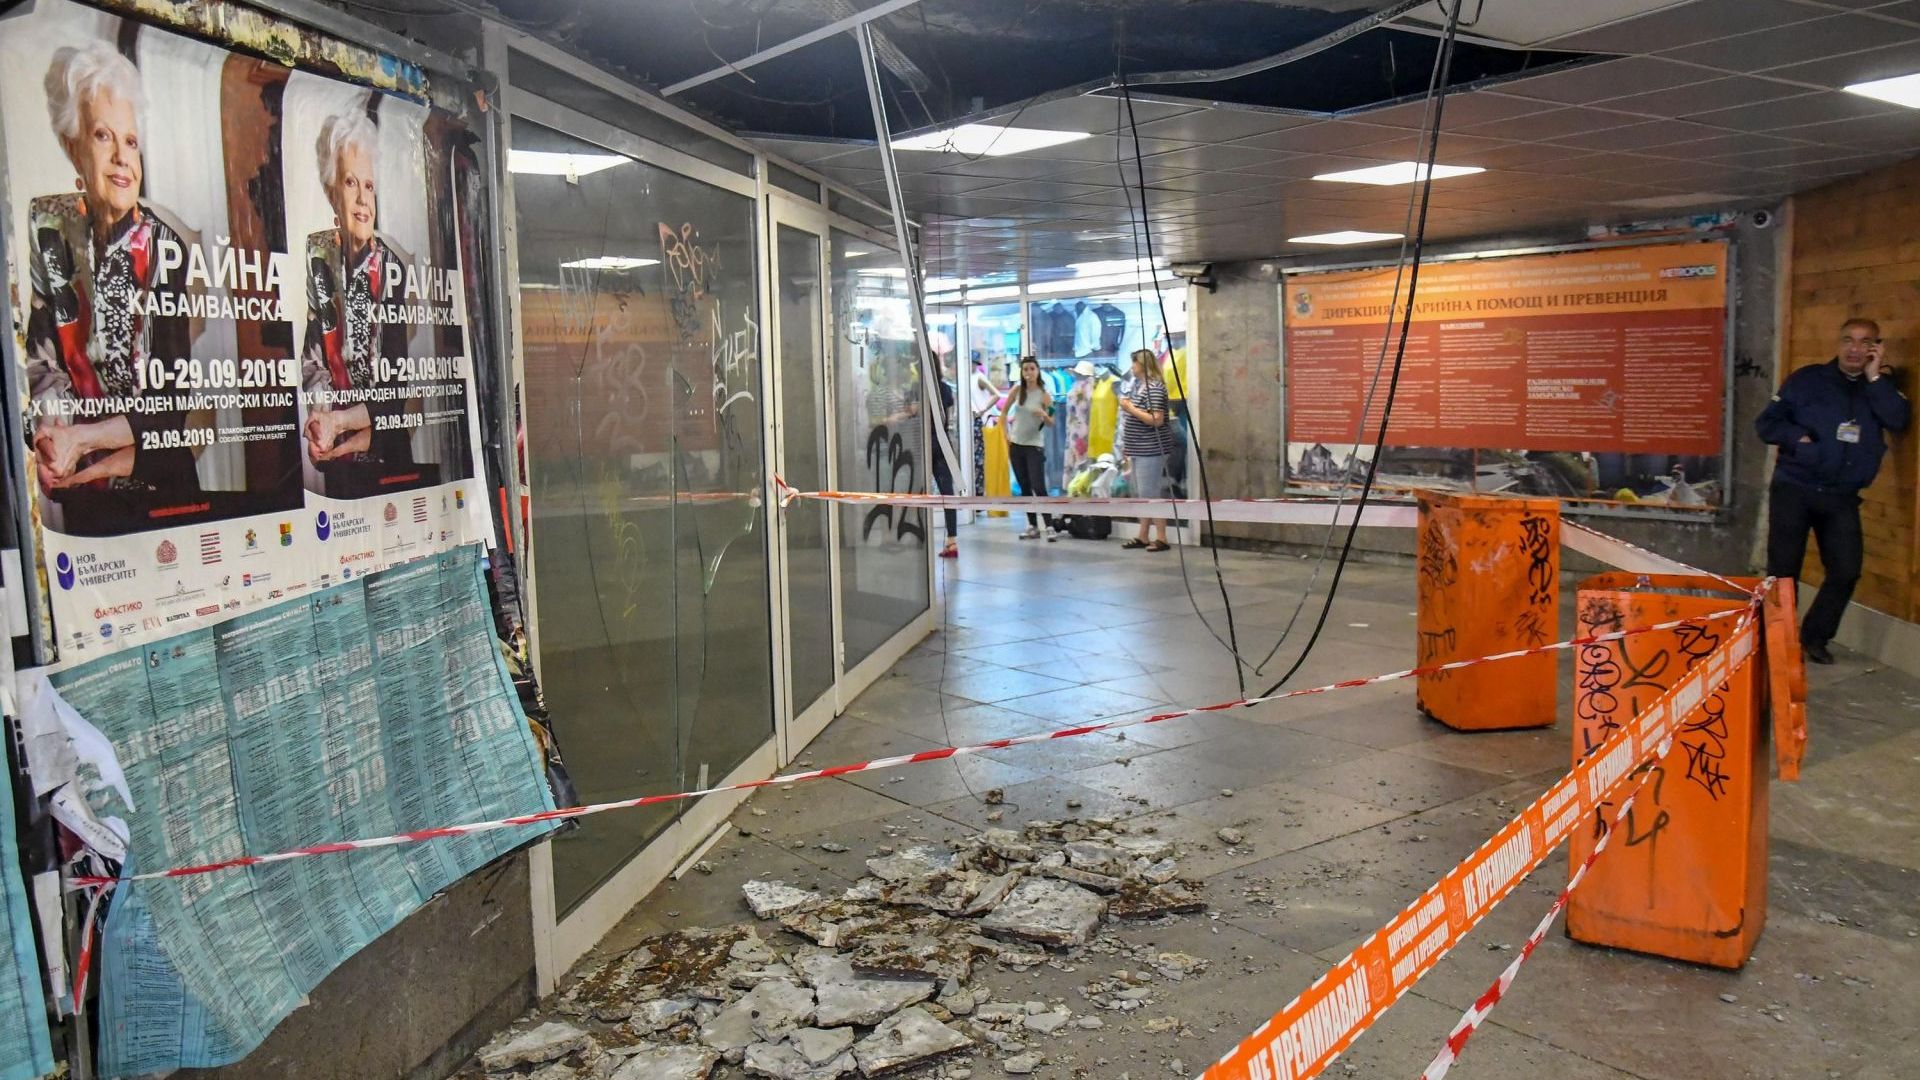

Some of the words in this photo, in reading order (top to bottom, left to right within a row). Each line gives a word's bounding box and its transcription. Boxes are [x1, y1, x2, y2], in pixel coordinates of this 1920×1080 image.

[157, 234, 288, 292] РАЙНА
[385, 257, 457, 301] РАЙНА
[128, 290, 288, 322] КАБАИВАНСКА
[368, 303, 458, 325] КАБАИВАНСКА
[1394, 298, 1473, 314] ААРИЙНА
[1477, 295, 1543, 312] ПОМОЩ
[1547, 294, 1558, 307] И
[1563, 289, 1668, 306] ПРЕВЕНЦИЯ
[137, 358, 292, 390] 10-29.09.2019
[373, 357, 460, 383] 10-29.09.2019
[47, 394, 176, 417] МЕЖДУНАРОДЕН
[177, 391, 260, 411] МАЙСТОРСКИ
[263, 392, 294, 407] КЛАС
[316, 386, 396, 405] МЕЖДУНАРОДЕН
[375, 413, 423, 431] 29.09.2019
[142, 427, 215, 450] 29.09.2019
[76, 553, 97, 566] НОВ
[78, 560, 126, 575] БЪЛГАРСКИ
[79, 568, 137, 588] УНИВЕРСИТЕТ
[1462, 871, 1478, 920] НЕ
[1475, 819, 1533, 909] ПРЕМИНАВАЙ!
[1248, 1047, 1271, 1080] НЕ
[1270, 959, 1372, 1080] ПРЕМИНАВАЙ!
